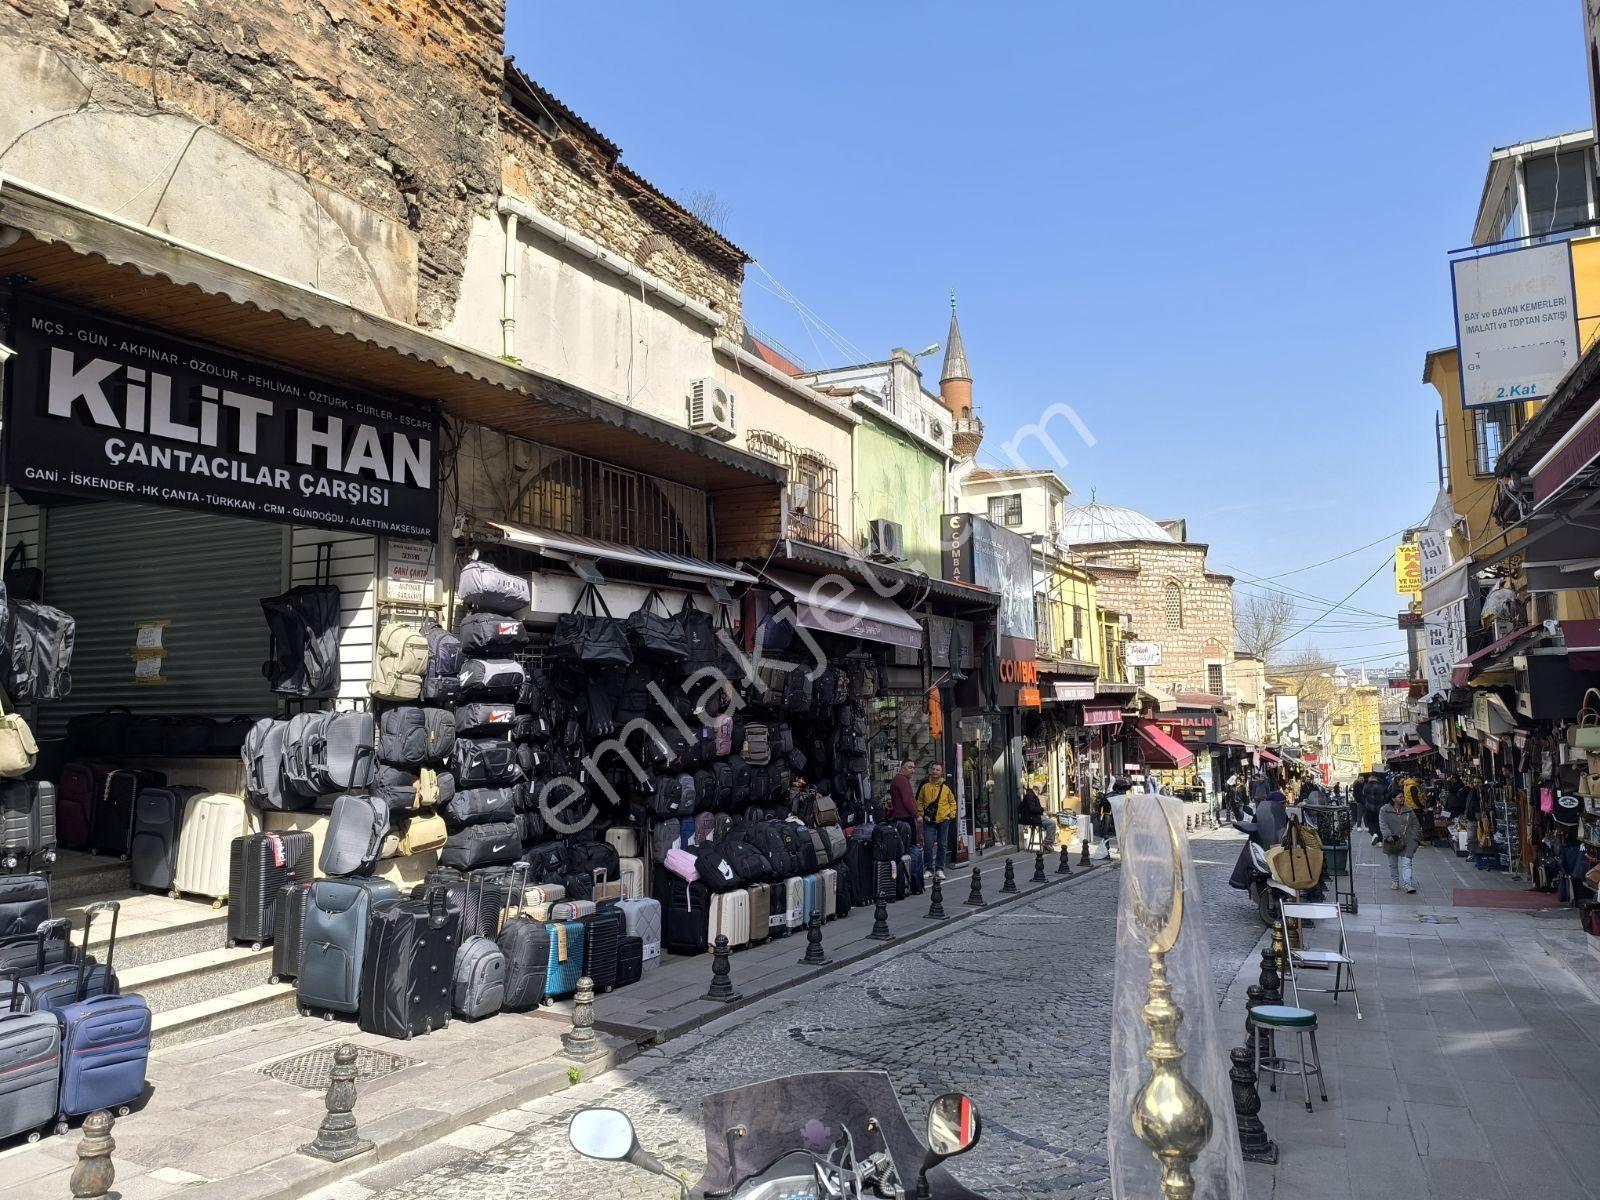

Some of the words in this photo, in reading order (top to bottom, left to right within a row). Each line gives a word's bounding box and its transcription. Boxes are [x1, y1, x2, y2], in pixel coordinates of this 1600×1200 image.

[1464, 311, 1481, 322] BAY
[1492, 305, 1519, 317] BAYAN
[1520, 296, 1567, 312] KEMERLERİ
[1508, 315, 1540, 327] TOPTAN
[1542, 310, 1568, 322] SATIŞI
[31, 317, 65, 339] MÇS
[77, 329, 108, 346] GÜN
[119, 341, 178, 365] AKPINAR
[399, 414, 433, 432] ESCAPE
[1496, 383, 1537, 398] 2.Kat
[104, 437, 291, 491] ÇANTACILAR
[299, 474, 390, 507] ÇARŞISI
[295, 407, 432, 490] HAN
[25, 467, 58, 482] GANİ
[70, 471, 134, 492] İSKENDER
[142, 485, 159, 497] HK
[162, 487, 199, 502] ÇANTA
[206, 493, 256, 511] TÜRKKAN
[263, 503, 286, 515] CRM
[350, 516, 389, 530] ALAETTİN
[389, 521, 431, 536] AKSESUAR
[951, 531, 961, 582] COMBAT
[1000, 659, 1038, 684] COMBAT
